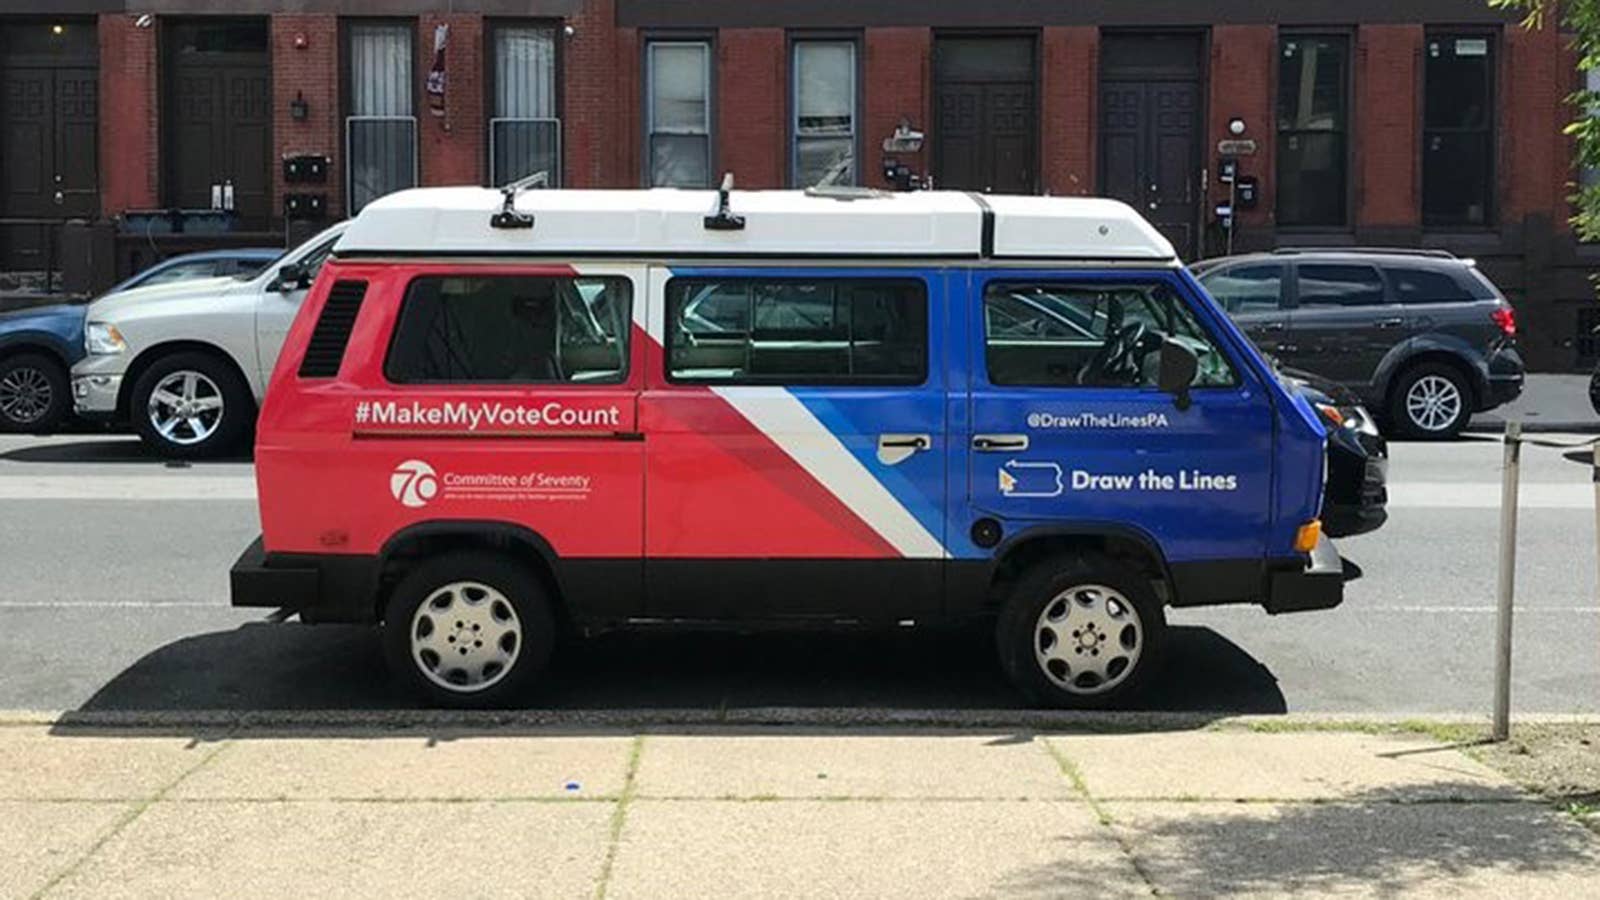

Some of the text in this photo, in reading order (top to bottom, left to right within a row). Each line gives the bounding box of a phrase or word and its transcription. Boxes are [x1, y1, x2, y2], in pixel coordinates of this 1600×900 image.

[355, 402, 619, 429] #MakeMyVoteCount
[1027, 413, 1169, 428] @DrawTheLinesPA
[443, 473, 590, 489] Committee of Seventy
[1071, 469, 1237, 490] Draw the Lines
